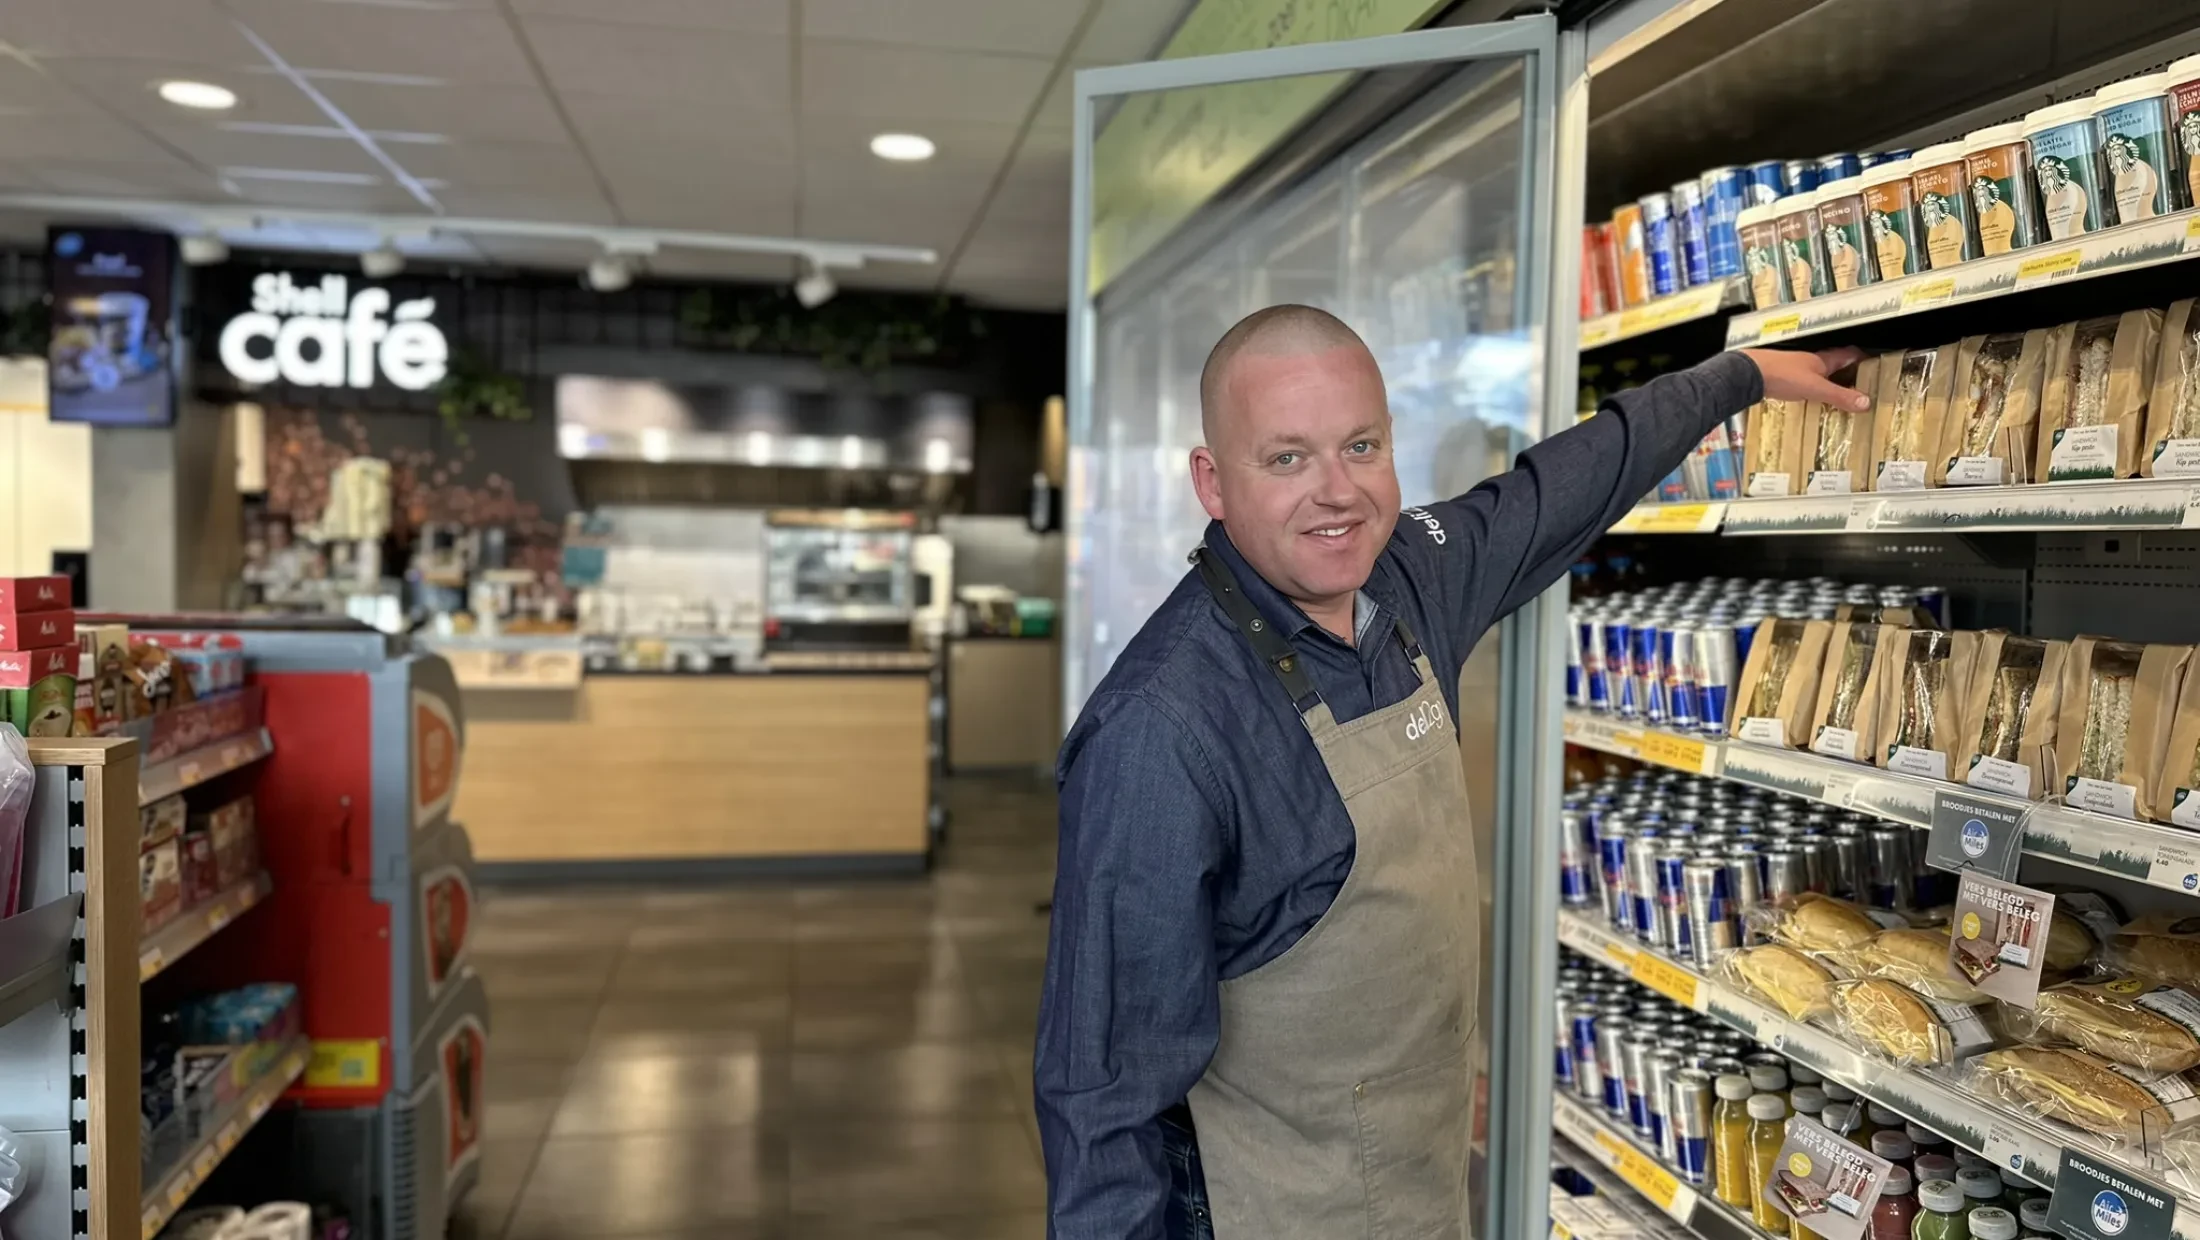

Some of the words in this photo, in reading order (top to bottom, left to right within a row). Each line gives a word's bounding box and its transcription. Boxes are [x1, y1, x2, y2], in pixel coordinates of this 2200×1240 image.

[252, 272, 347, 317] Shell
[219, 287, 448, 391] café
[1941, 799, 1974, 815] BROODJES
[1974, 807, 2002, 821] BETALEN
[2002, 813, 2017, 824] MET
[1965, 837, 1985, 850] Miles
[1966, 827, 1979, 838] Air
[1962, 890, 1979, 904] MET
[1981, 896, 2005, 912] VERS
[2006, 904, 2041, 923] BELEG
[1964, 880, 1985, 896] VERS
[1986, 887, 2025, 907] BELEGD
[1793, 1131, 1814, 1149] MET
[1815, 1143, 1842, 1164] VERS
[1842, 1159, 1877, 1183] BELEG
[1797, 1123, 1822, 1144] VERS
[1823, 1137, 1864, 1166] BELEGD
[2069, 1158, 2110, 1185] BROODJES
[2111, 1178, 2146, 1201] BETALEN
[2146, 1195, 2165, 1210] MET
[2096, 1208, 2122, 1229] Miles
[2099, 1198, 2114, 1212] Air
